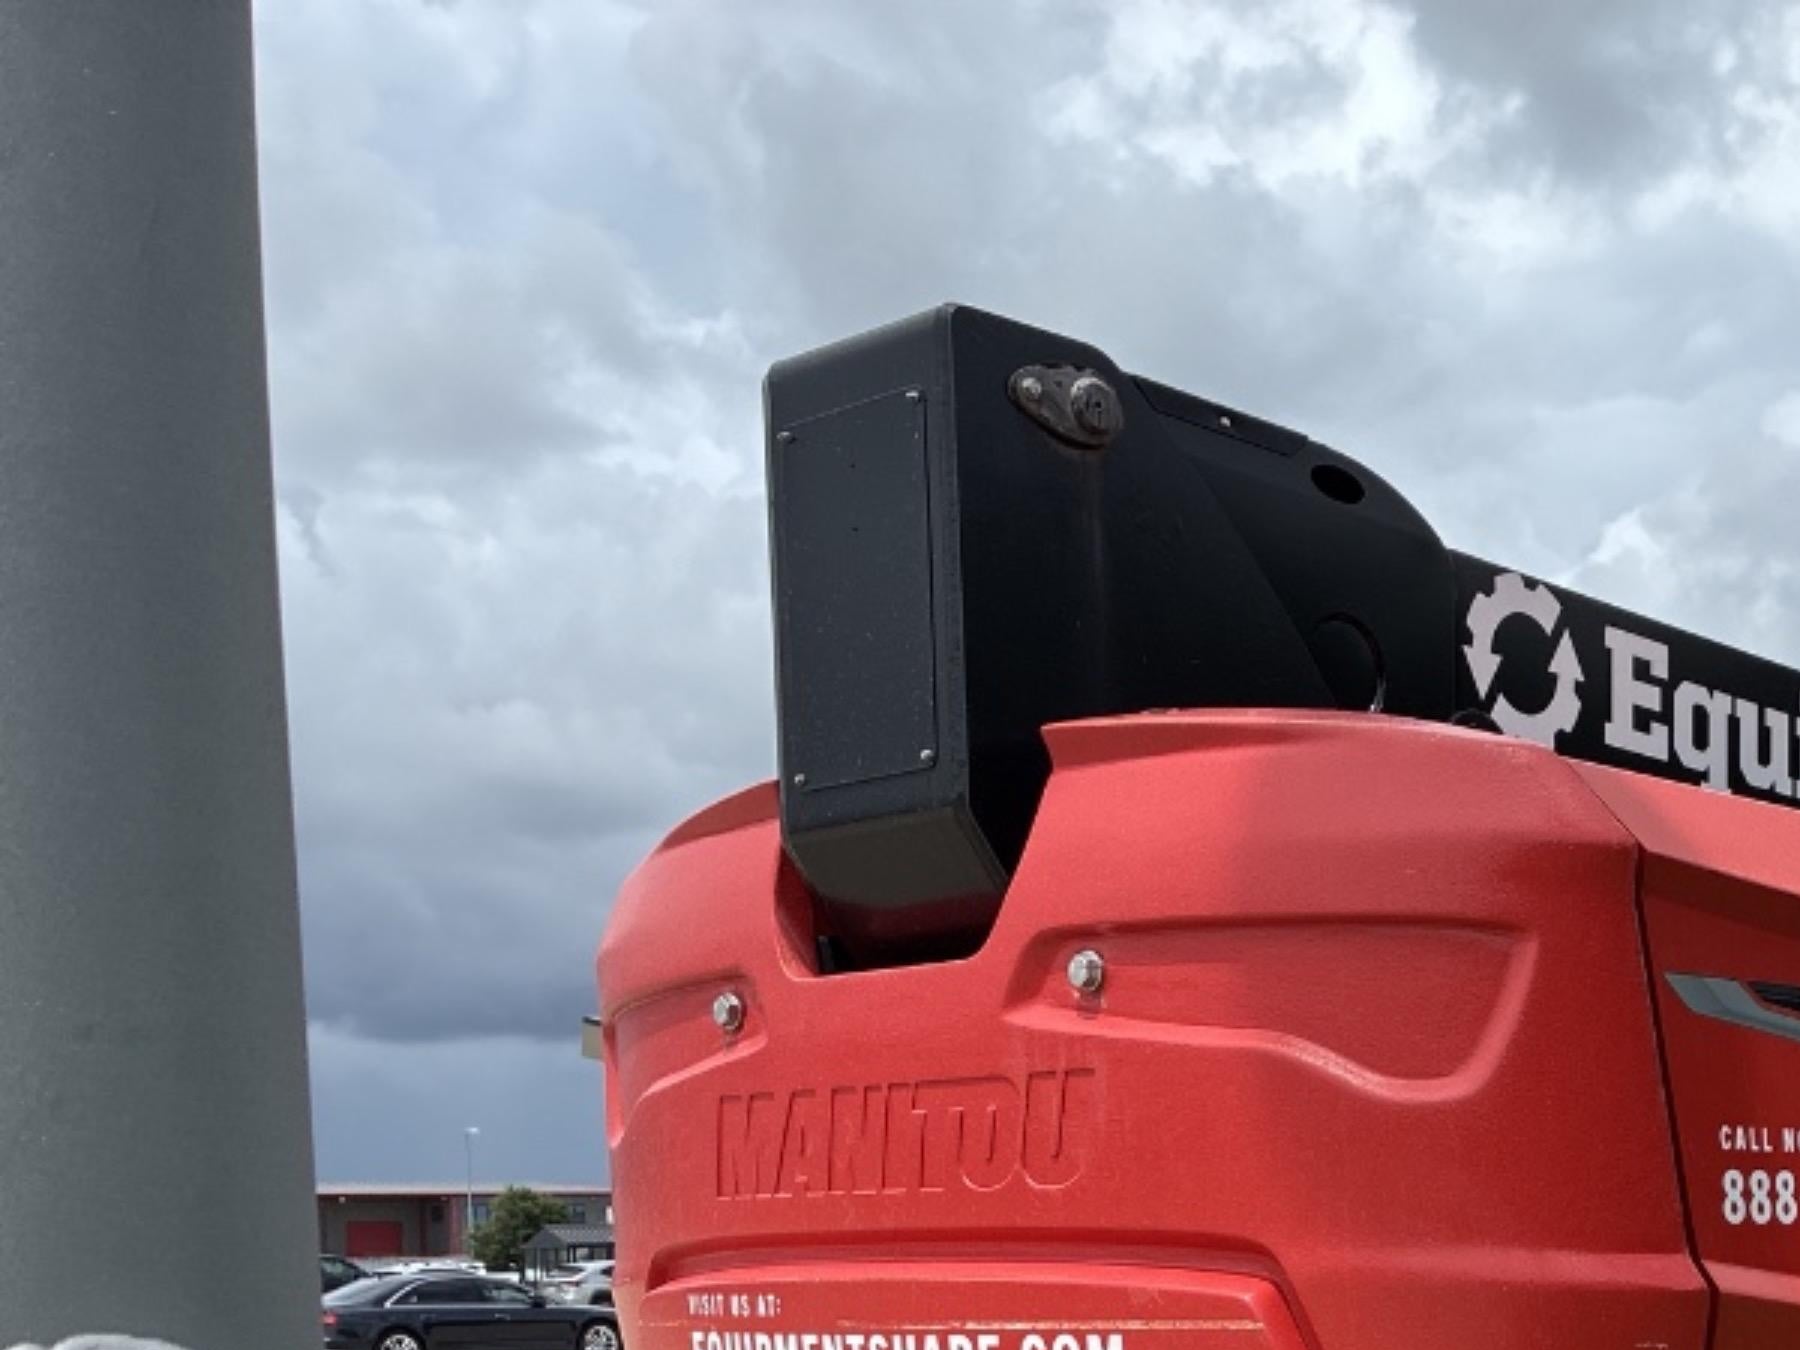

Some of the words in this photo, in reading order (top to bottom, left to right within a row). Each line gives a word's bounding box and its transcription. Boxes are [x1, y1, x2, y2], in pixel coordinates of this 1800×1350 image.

[716, 1068, 1096, 1200] MANITOU
[1719, 1125, 1773, 1152] CALL
[688, 1293, 724, 1316] VISIT
[730, 1294, 750, 1317] US
[757, 1293, 781, 1317] AT:
